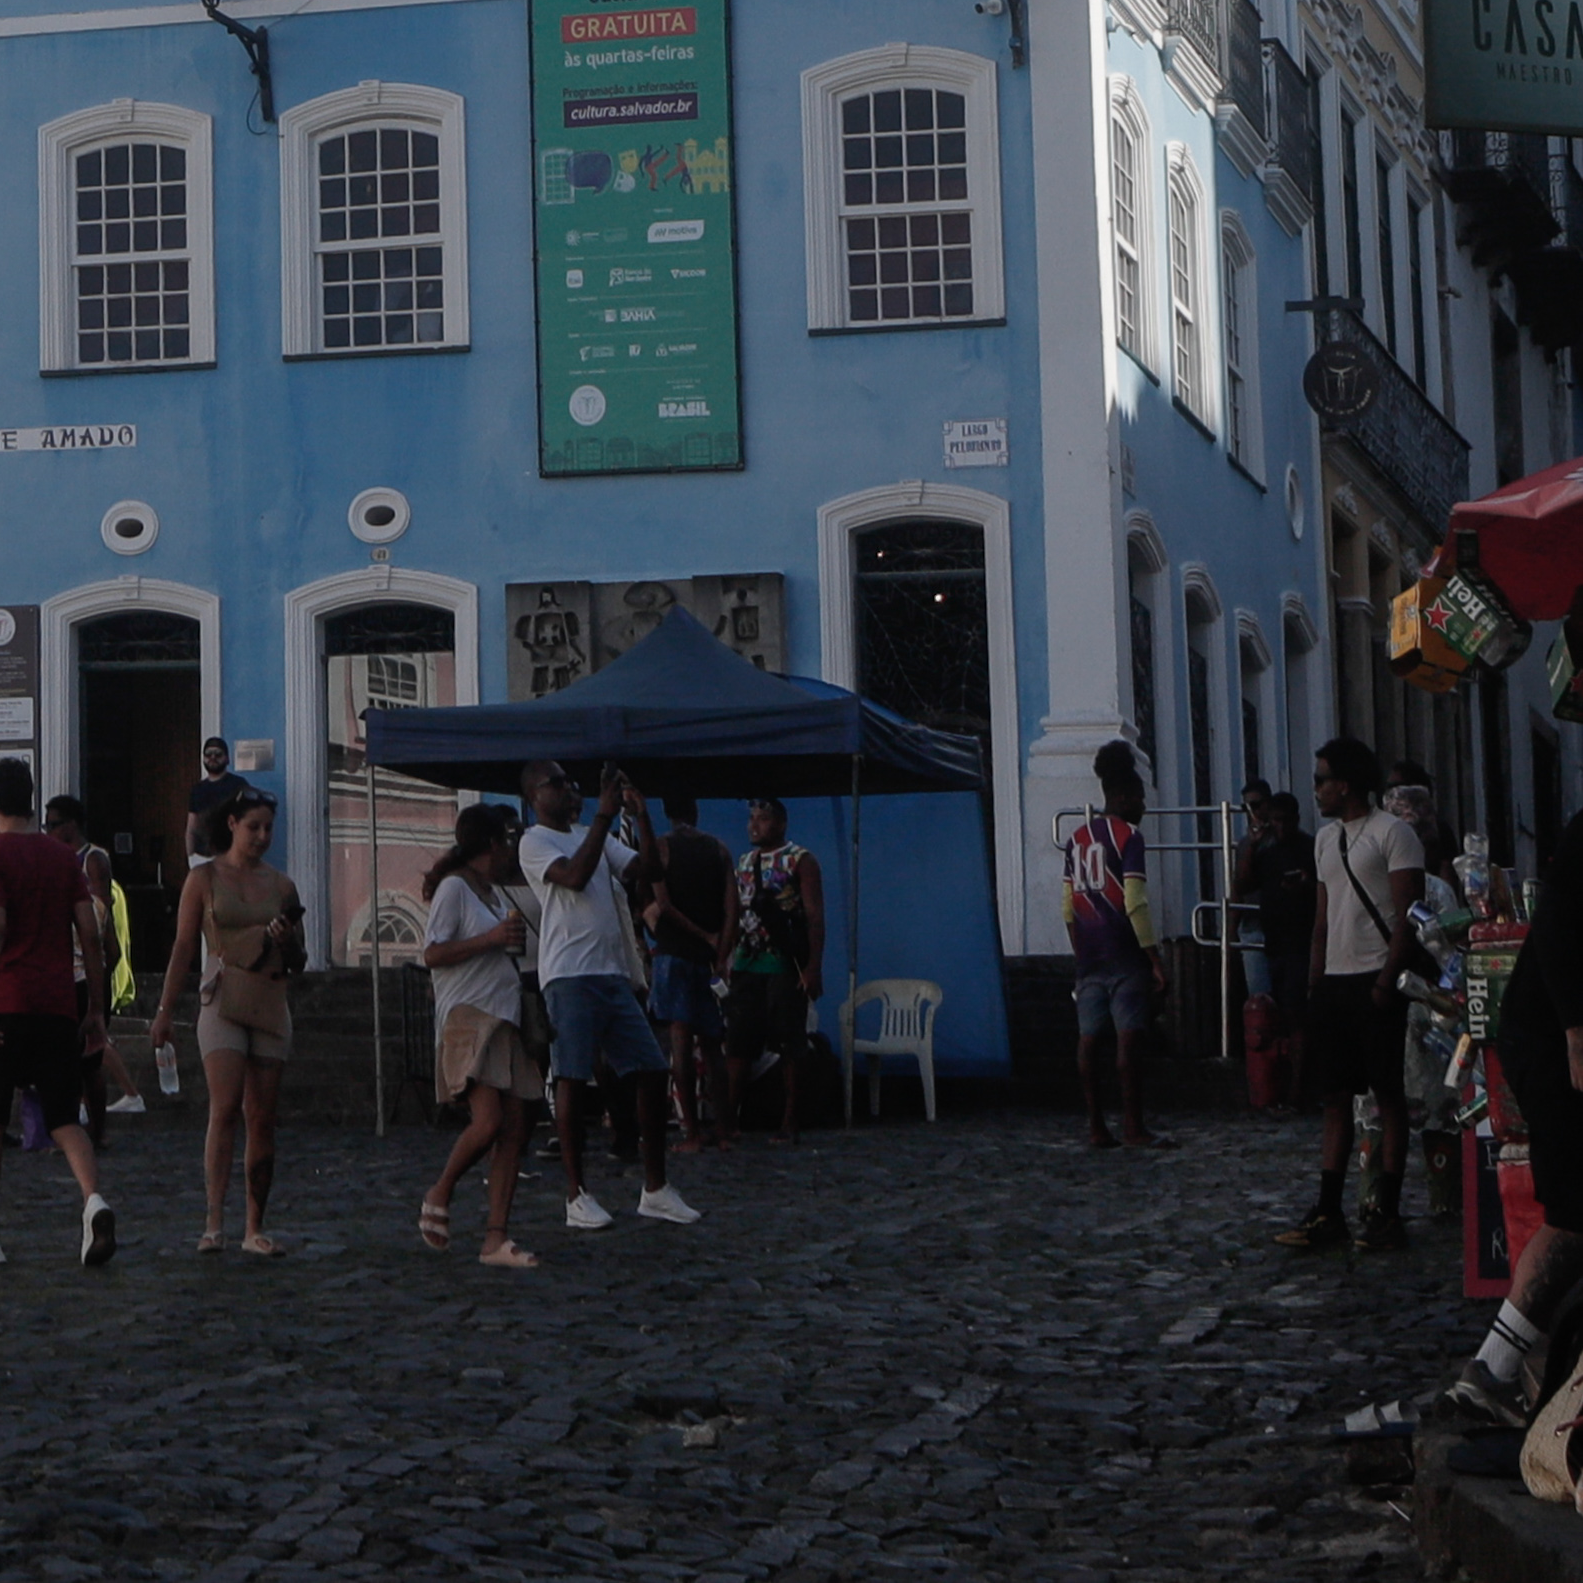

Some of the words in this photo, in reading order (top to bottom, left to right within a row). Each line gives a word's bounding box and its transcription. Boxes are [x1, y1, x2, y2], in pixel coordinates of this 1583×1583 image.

[570, 12, 688, 38] GRATUITA
[564, 50, 582, 68] às
[586, 44, 695, 70] quartas-feiras
[1495, 61, 1573, 86] MAESTRO
[562, 84, 625, 99] Programação
[570, 99, 693, 120] cultura.salvador.br
[40, 425, 134, 450] AMADO
[1072, 842, 1106, 892] 10
